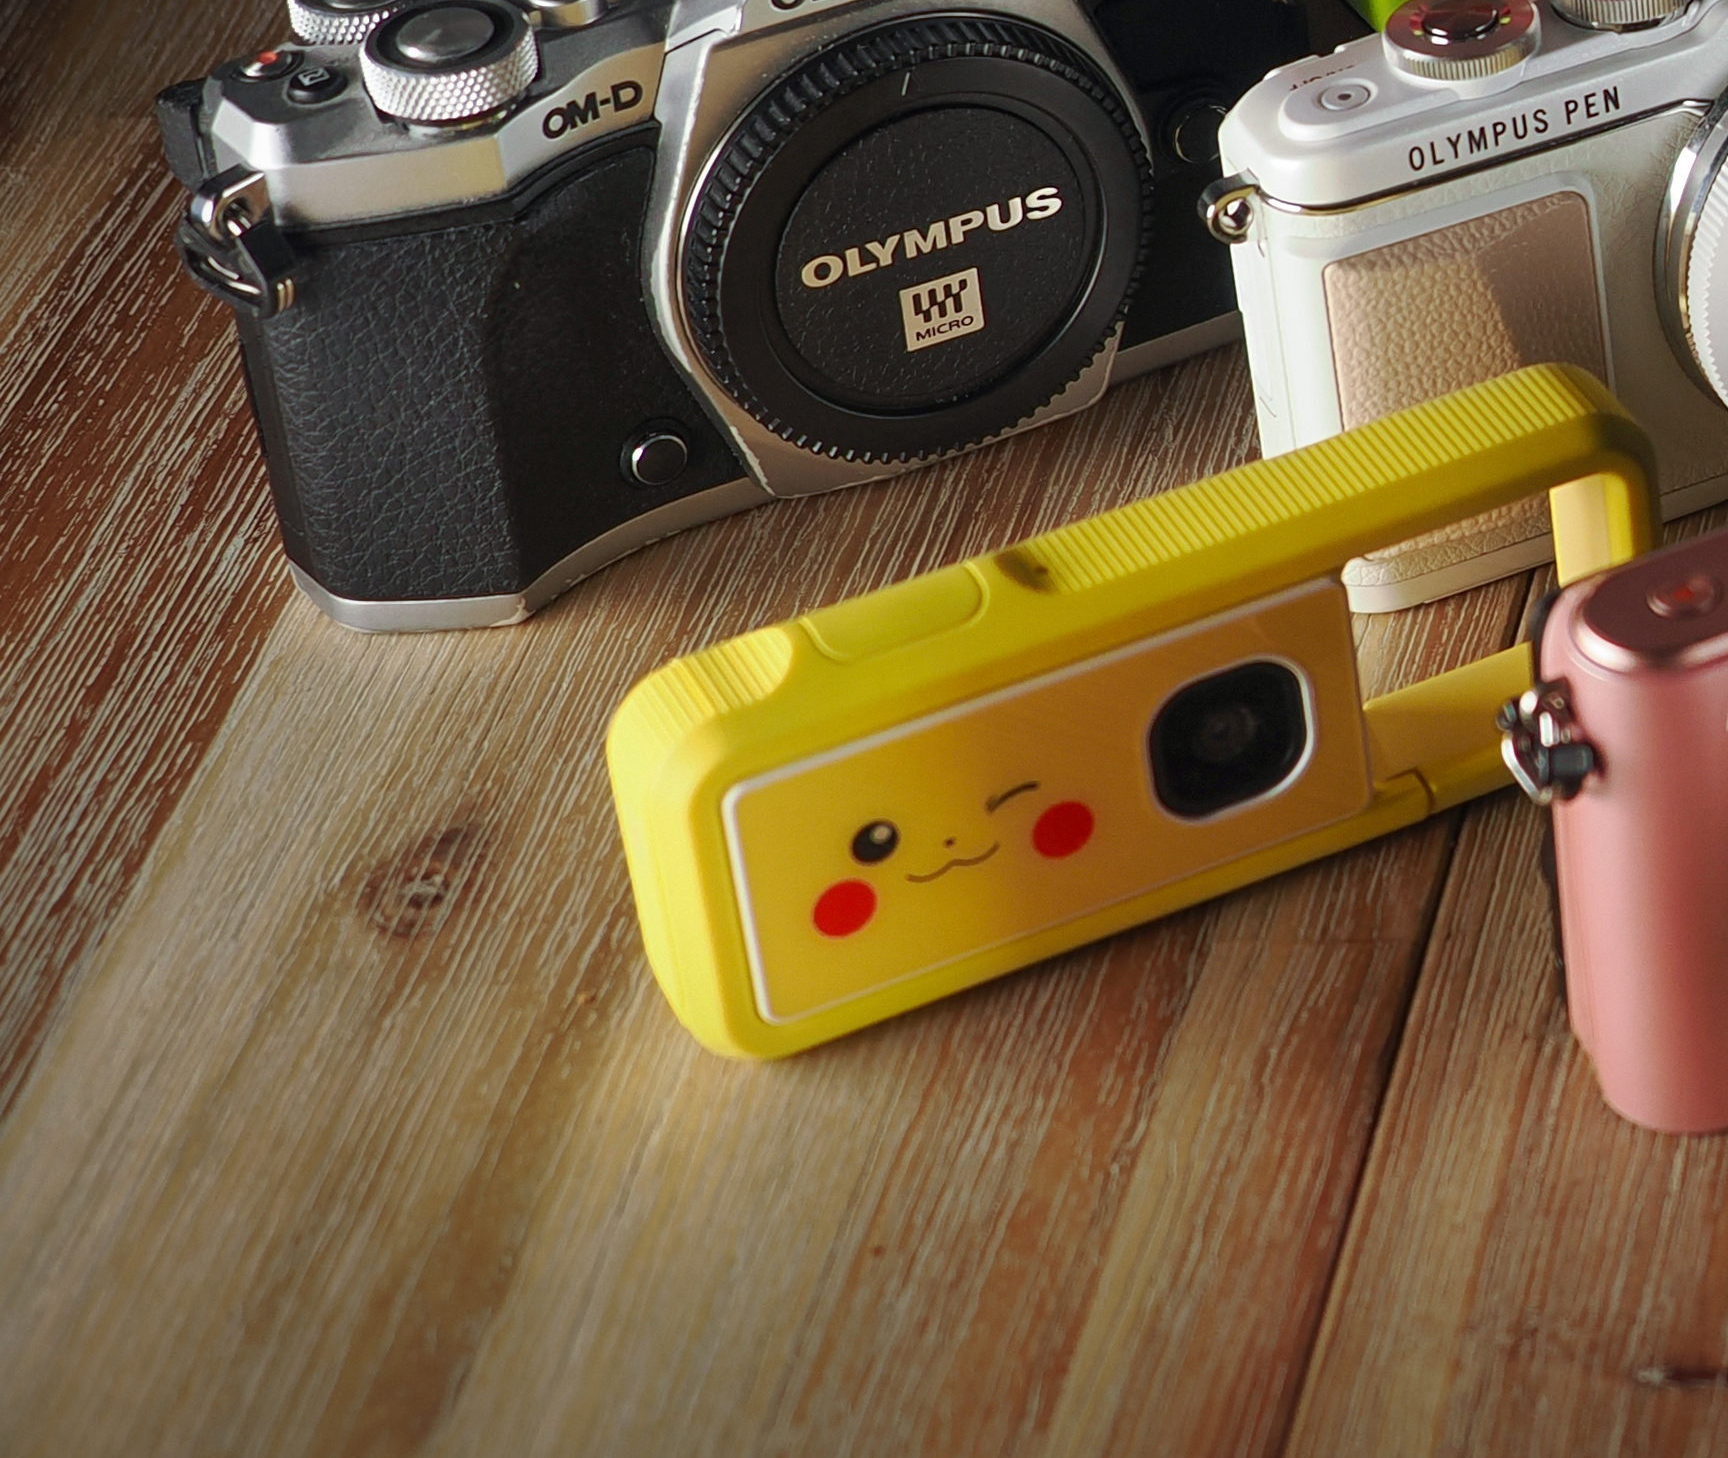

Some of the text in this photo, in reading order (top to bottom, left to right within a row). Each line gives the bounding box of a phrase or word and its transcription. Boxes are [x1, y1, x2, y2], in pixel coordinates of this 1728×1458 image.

[542, 80, 644, 139] OM-D
[1408, 85, 1621, 171] OLYMPUS PEN
[801, 186, 1062, 288] OLYMPUS
[916, 315, 974, 342] MICRO
